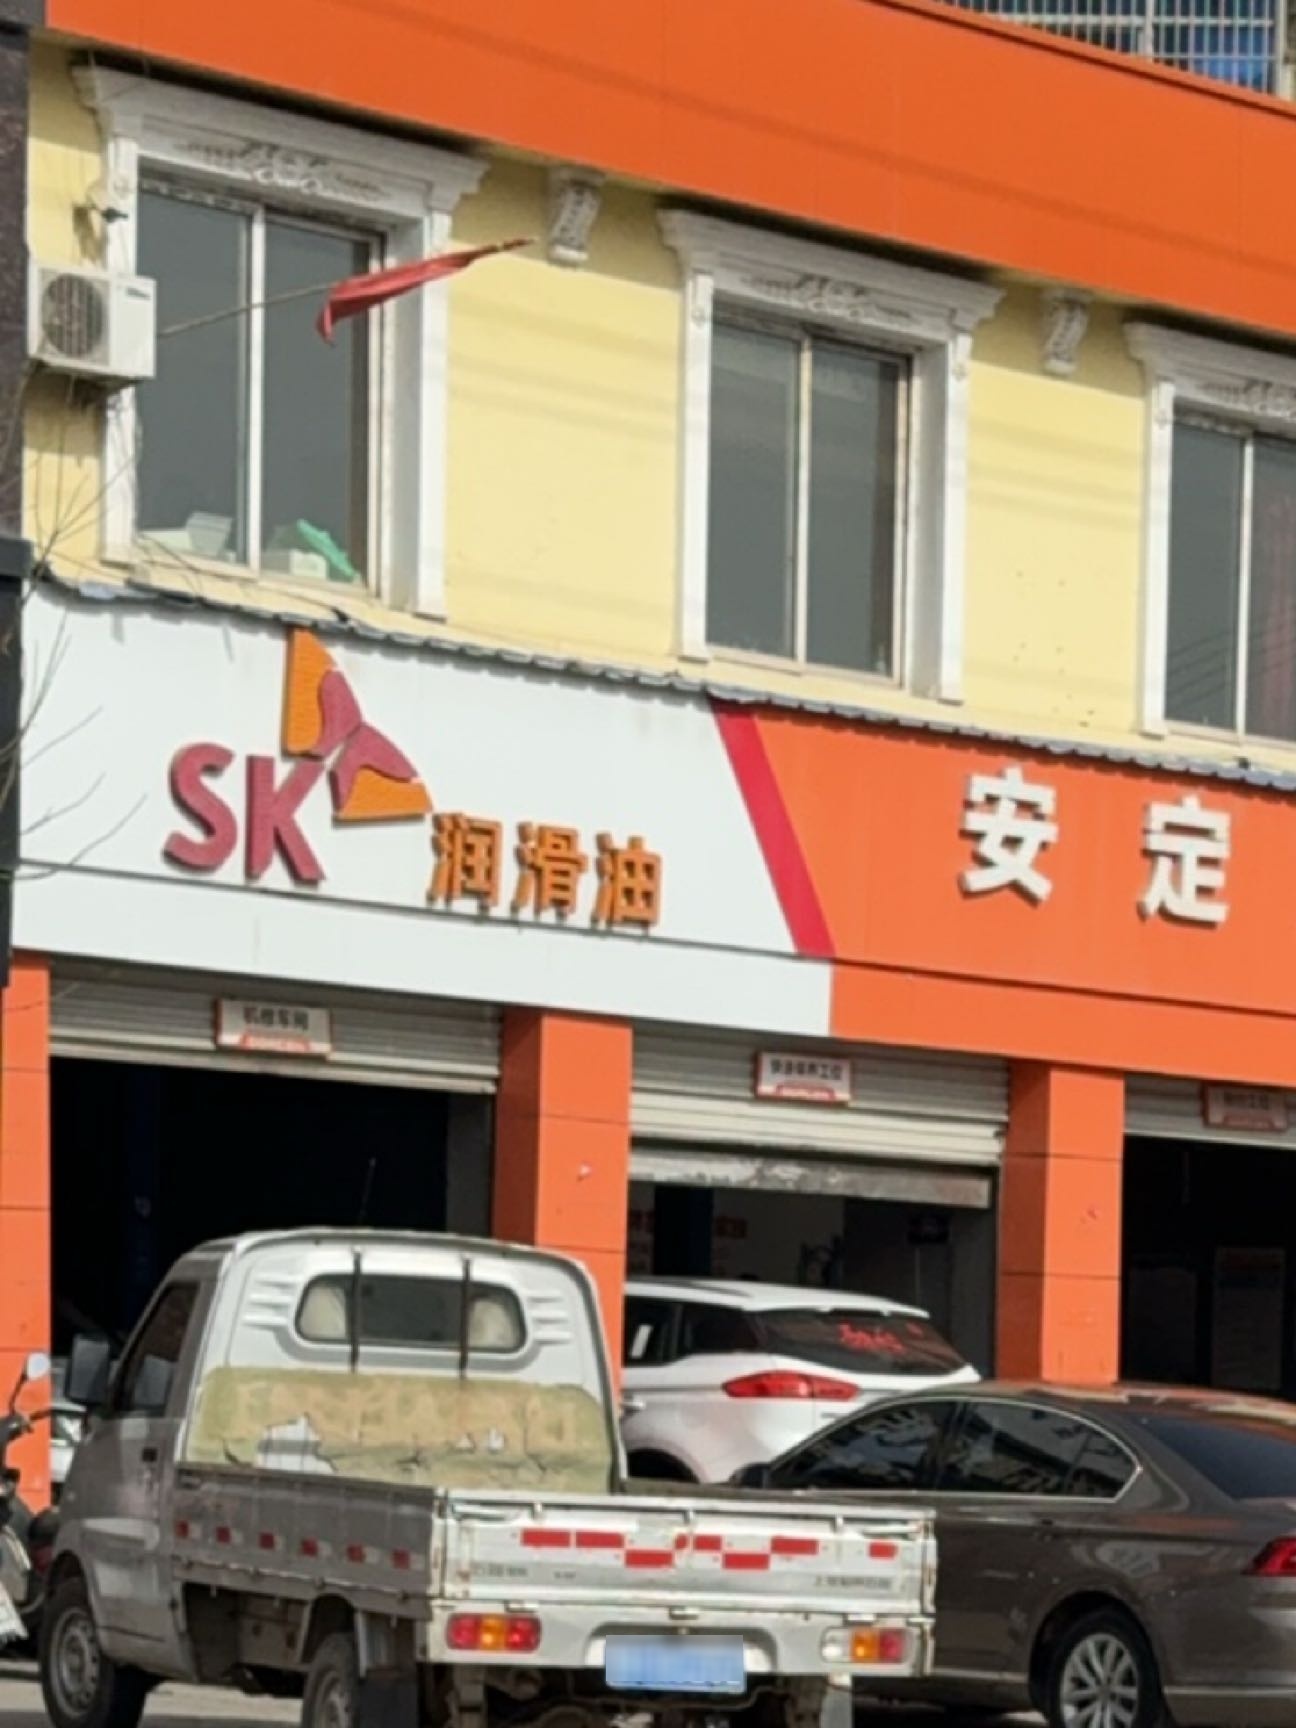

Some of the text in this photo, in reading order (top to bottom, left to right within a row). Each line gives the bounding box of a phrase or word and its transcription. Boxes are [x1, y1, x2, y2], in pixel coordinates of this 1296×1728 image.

[165, 742, 326, 888] SK
[426, 812, 662, 934] 润滑油
